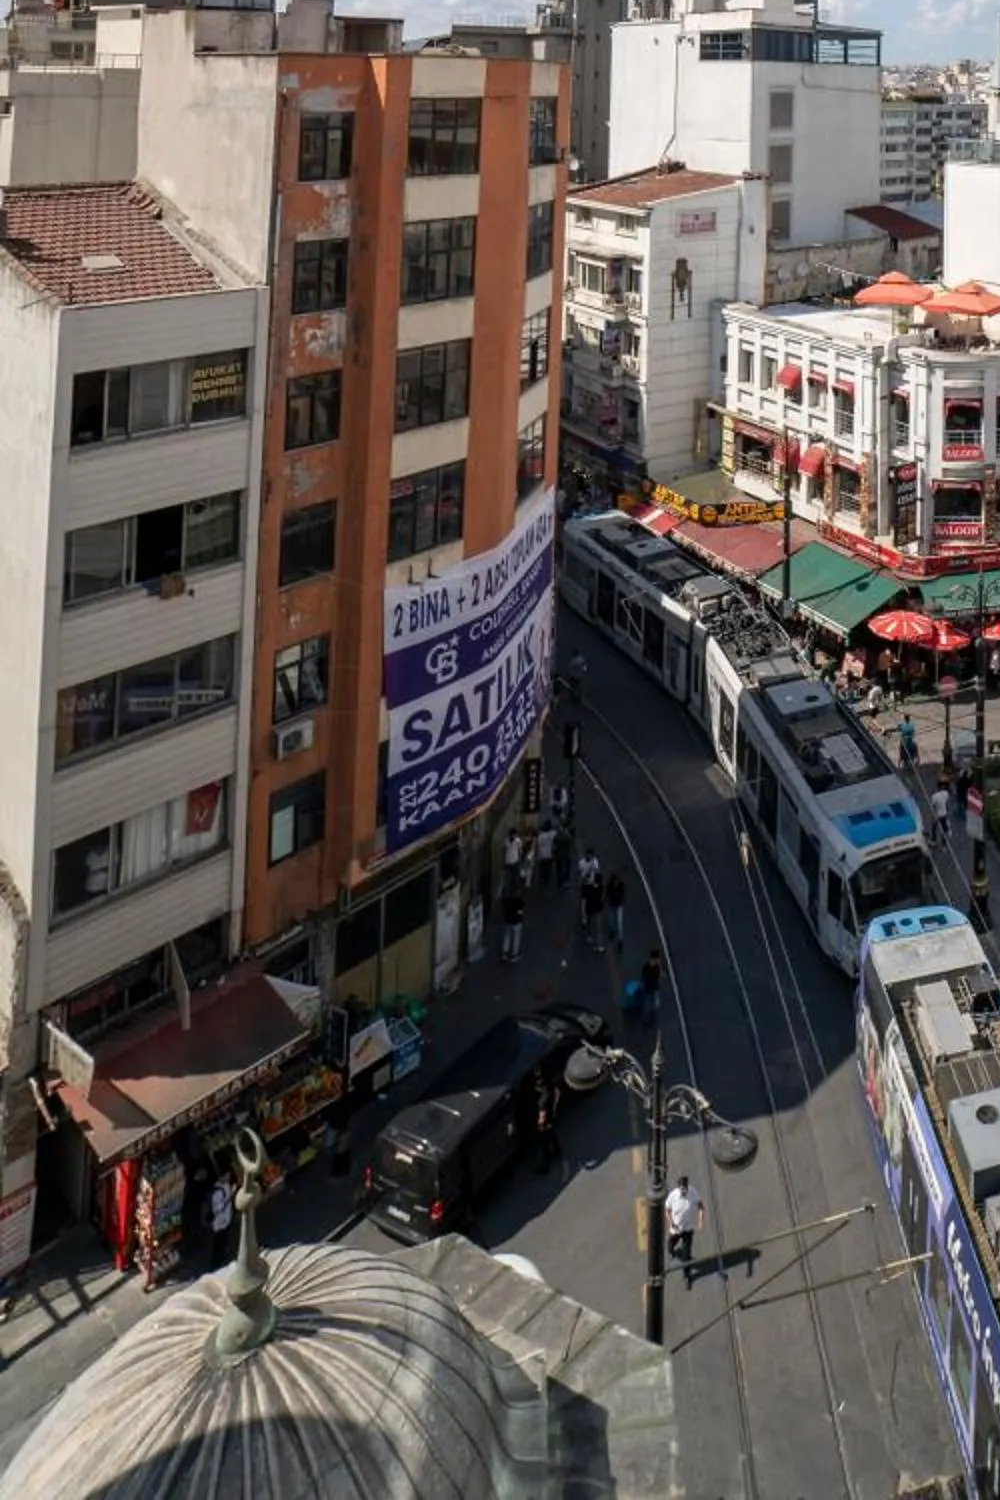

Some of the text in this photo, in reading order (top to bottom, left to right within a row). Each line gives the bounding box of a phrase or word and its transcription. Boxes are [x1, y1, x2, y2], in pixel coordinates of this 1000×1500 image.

[393, 604, 404, 639] 2
[471, 573, 480, 606] 2
[401, 623, 536, 762] SATILIK
[399, 770, 488, 833] KAAN
[418, 743, 491, 806] 240
